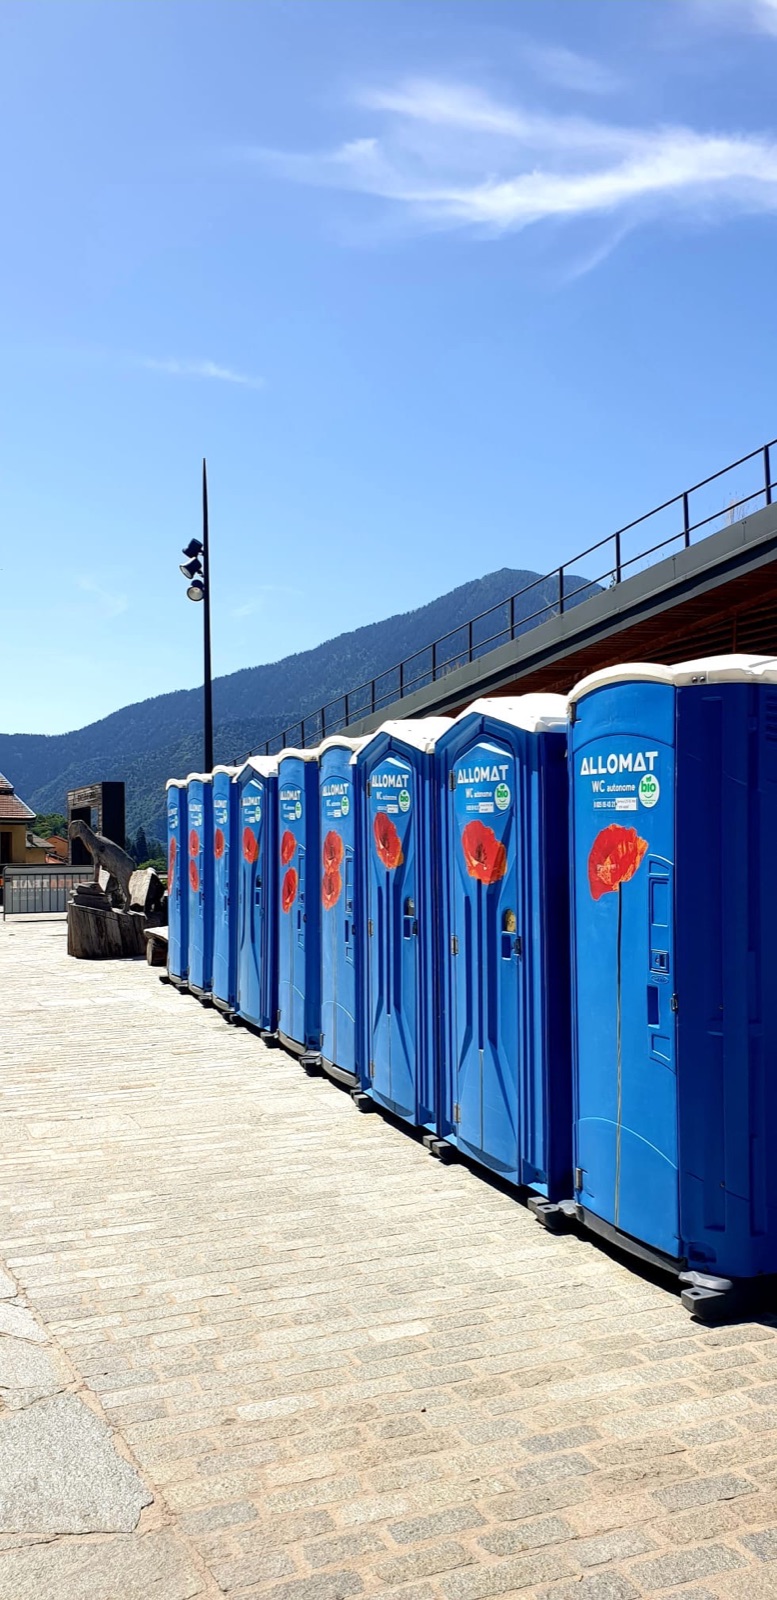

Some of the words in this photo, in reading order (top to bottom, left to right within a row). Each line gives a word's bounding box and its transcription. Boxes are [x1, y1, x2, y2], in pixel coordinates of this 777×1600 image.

[580, 751, 658, 775] ALLOMAT
[457, 764, 509, 784] ALLOMAT
[371, 774, 409, 788] ALLOMAT
[591, 780, 605, 793] WC
[606, 783, 636, 792] autonome
[640, 781, 656, 792] bio
[322, 783, 349, 796] ALLOMAT
[496, 787, 509, 798] bio
